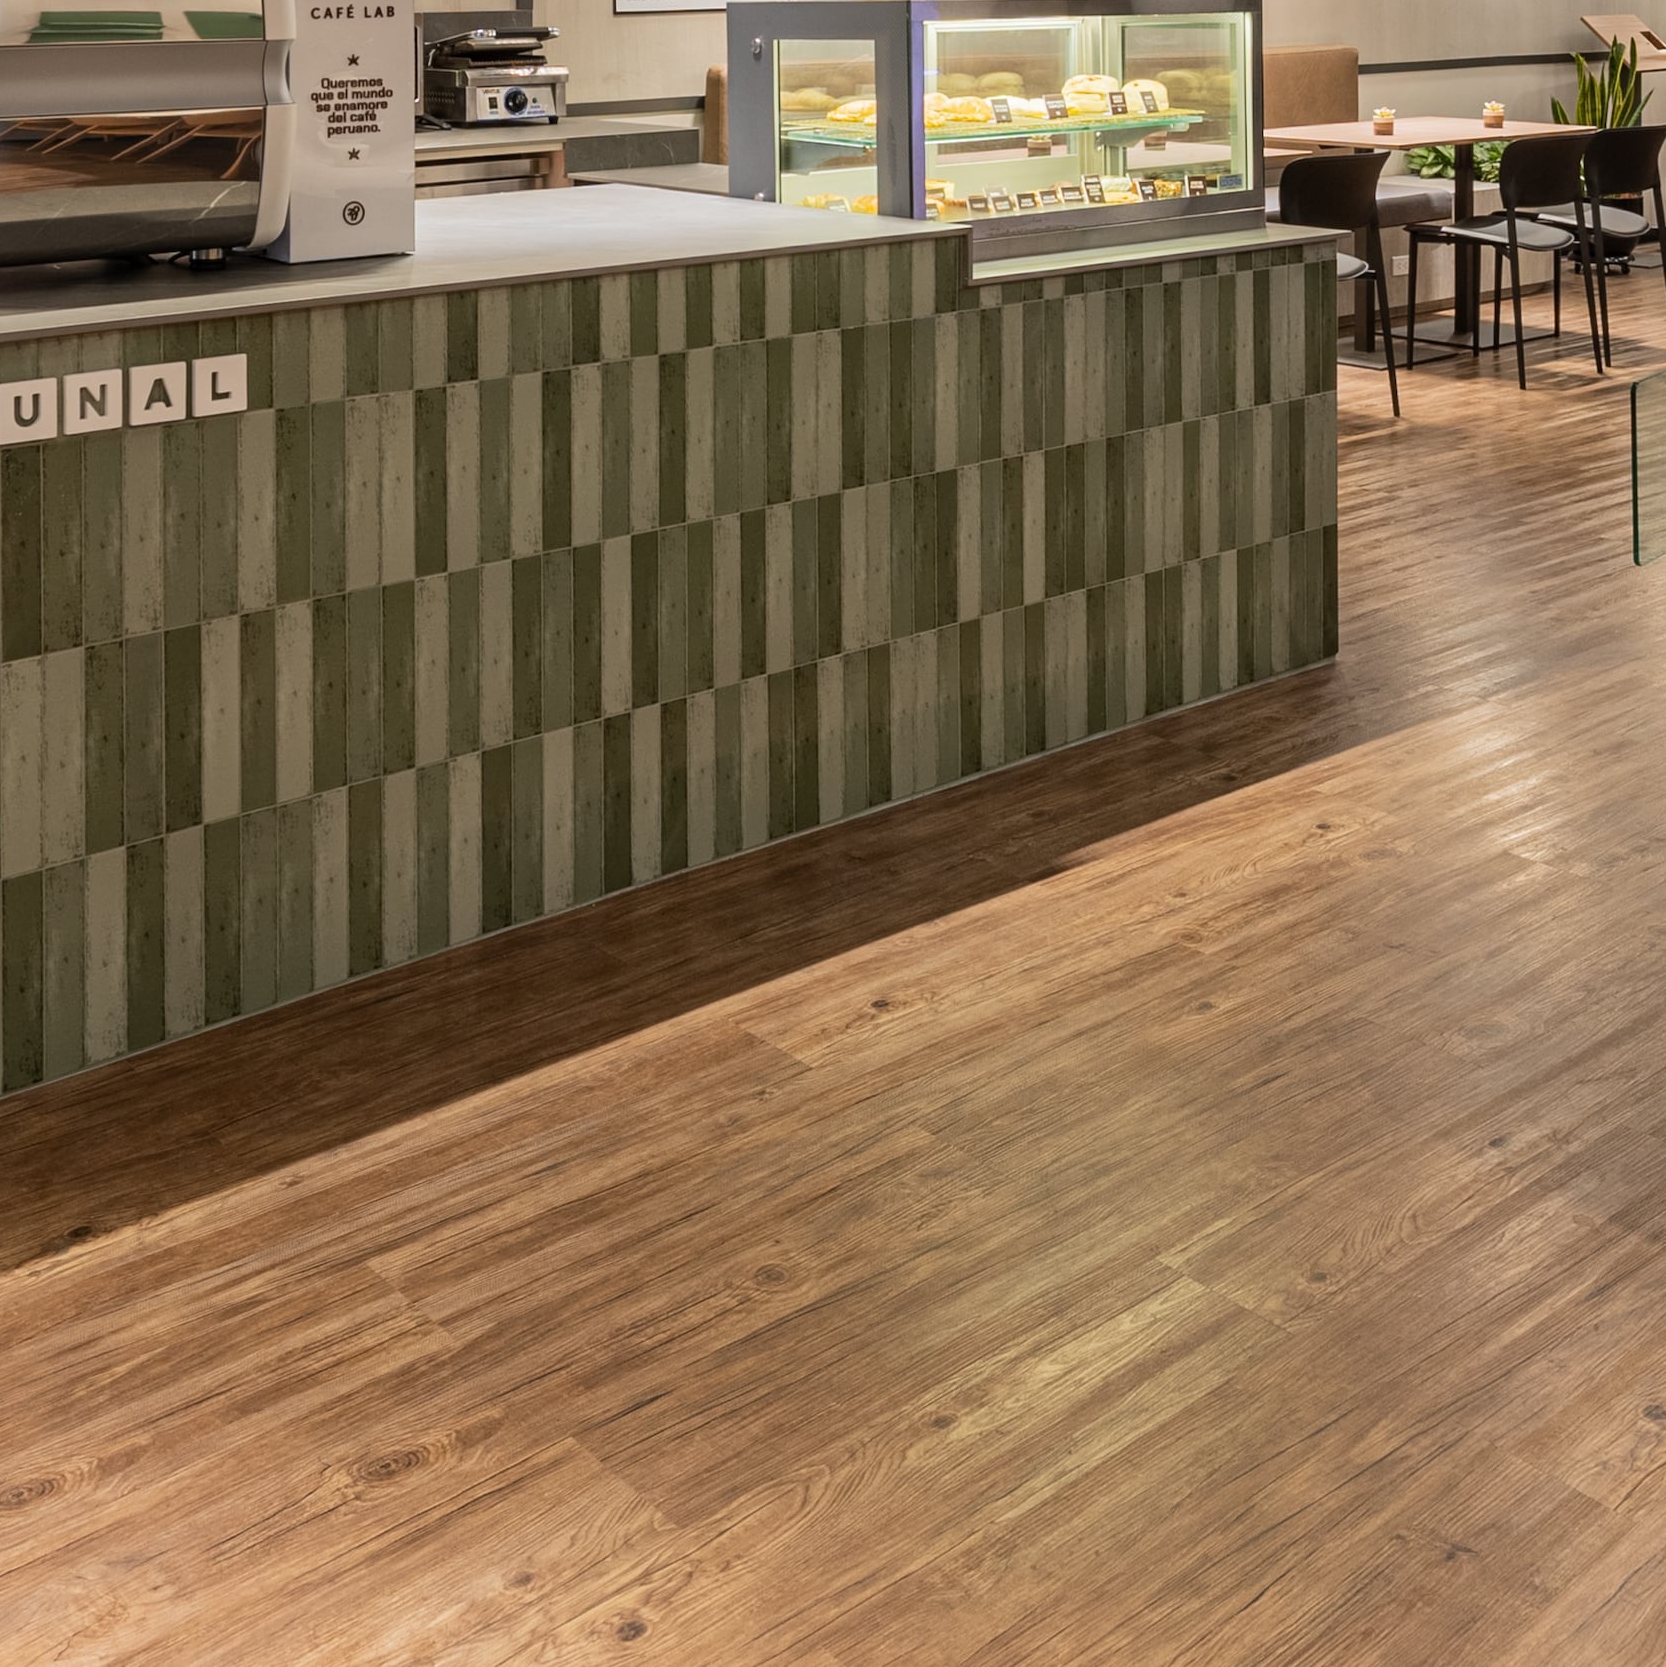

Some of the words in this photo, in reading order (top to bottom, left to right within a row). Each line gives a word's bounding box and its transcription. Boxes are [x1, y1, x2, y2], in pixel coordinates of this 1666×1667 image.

[311, 4, 354, 20] CAFÉ
[364, 6, 396, 19] LAB
[321, 78, 383, 90] Queremos
[311, 90, 334, 102] que
[337, 89, 349, 100] el
[351, 87, 393, 100] mundo
[316, 102, 331, 112] se
[334, 100, 388, 111] enamore
[328, 111, 346, 124] del
[350, 110, 377, 123] café
[327, 124, 381, 138] peruano.
